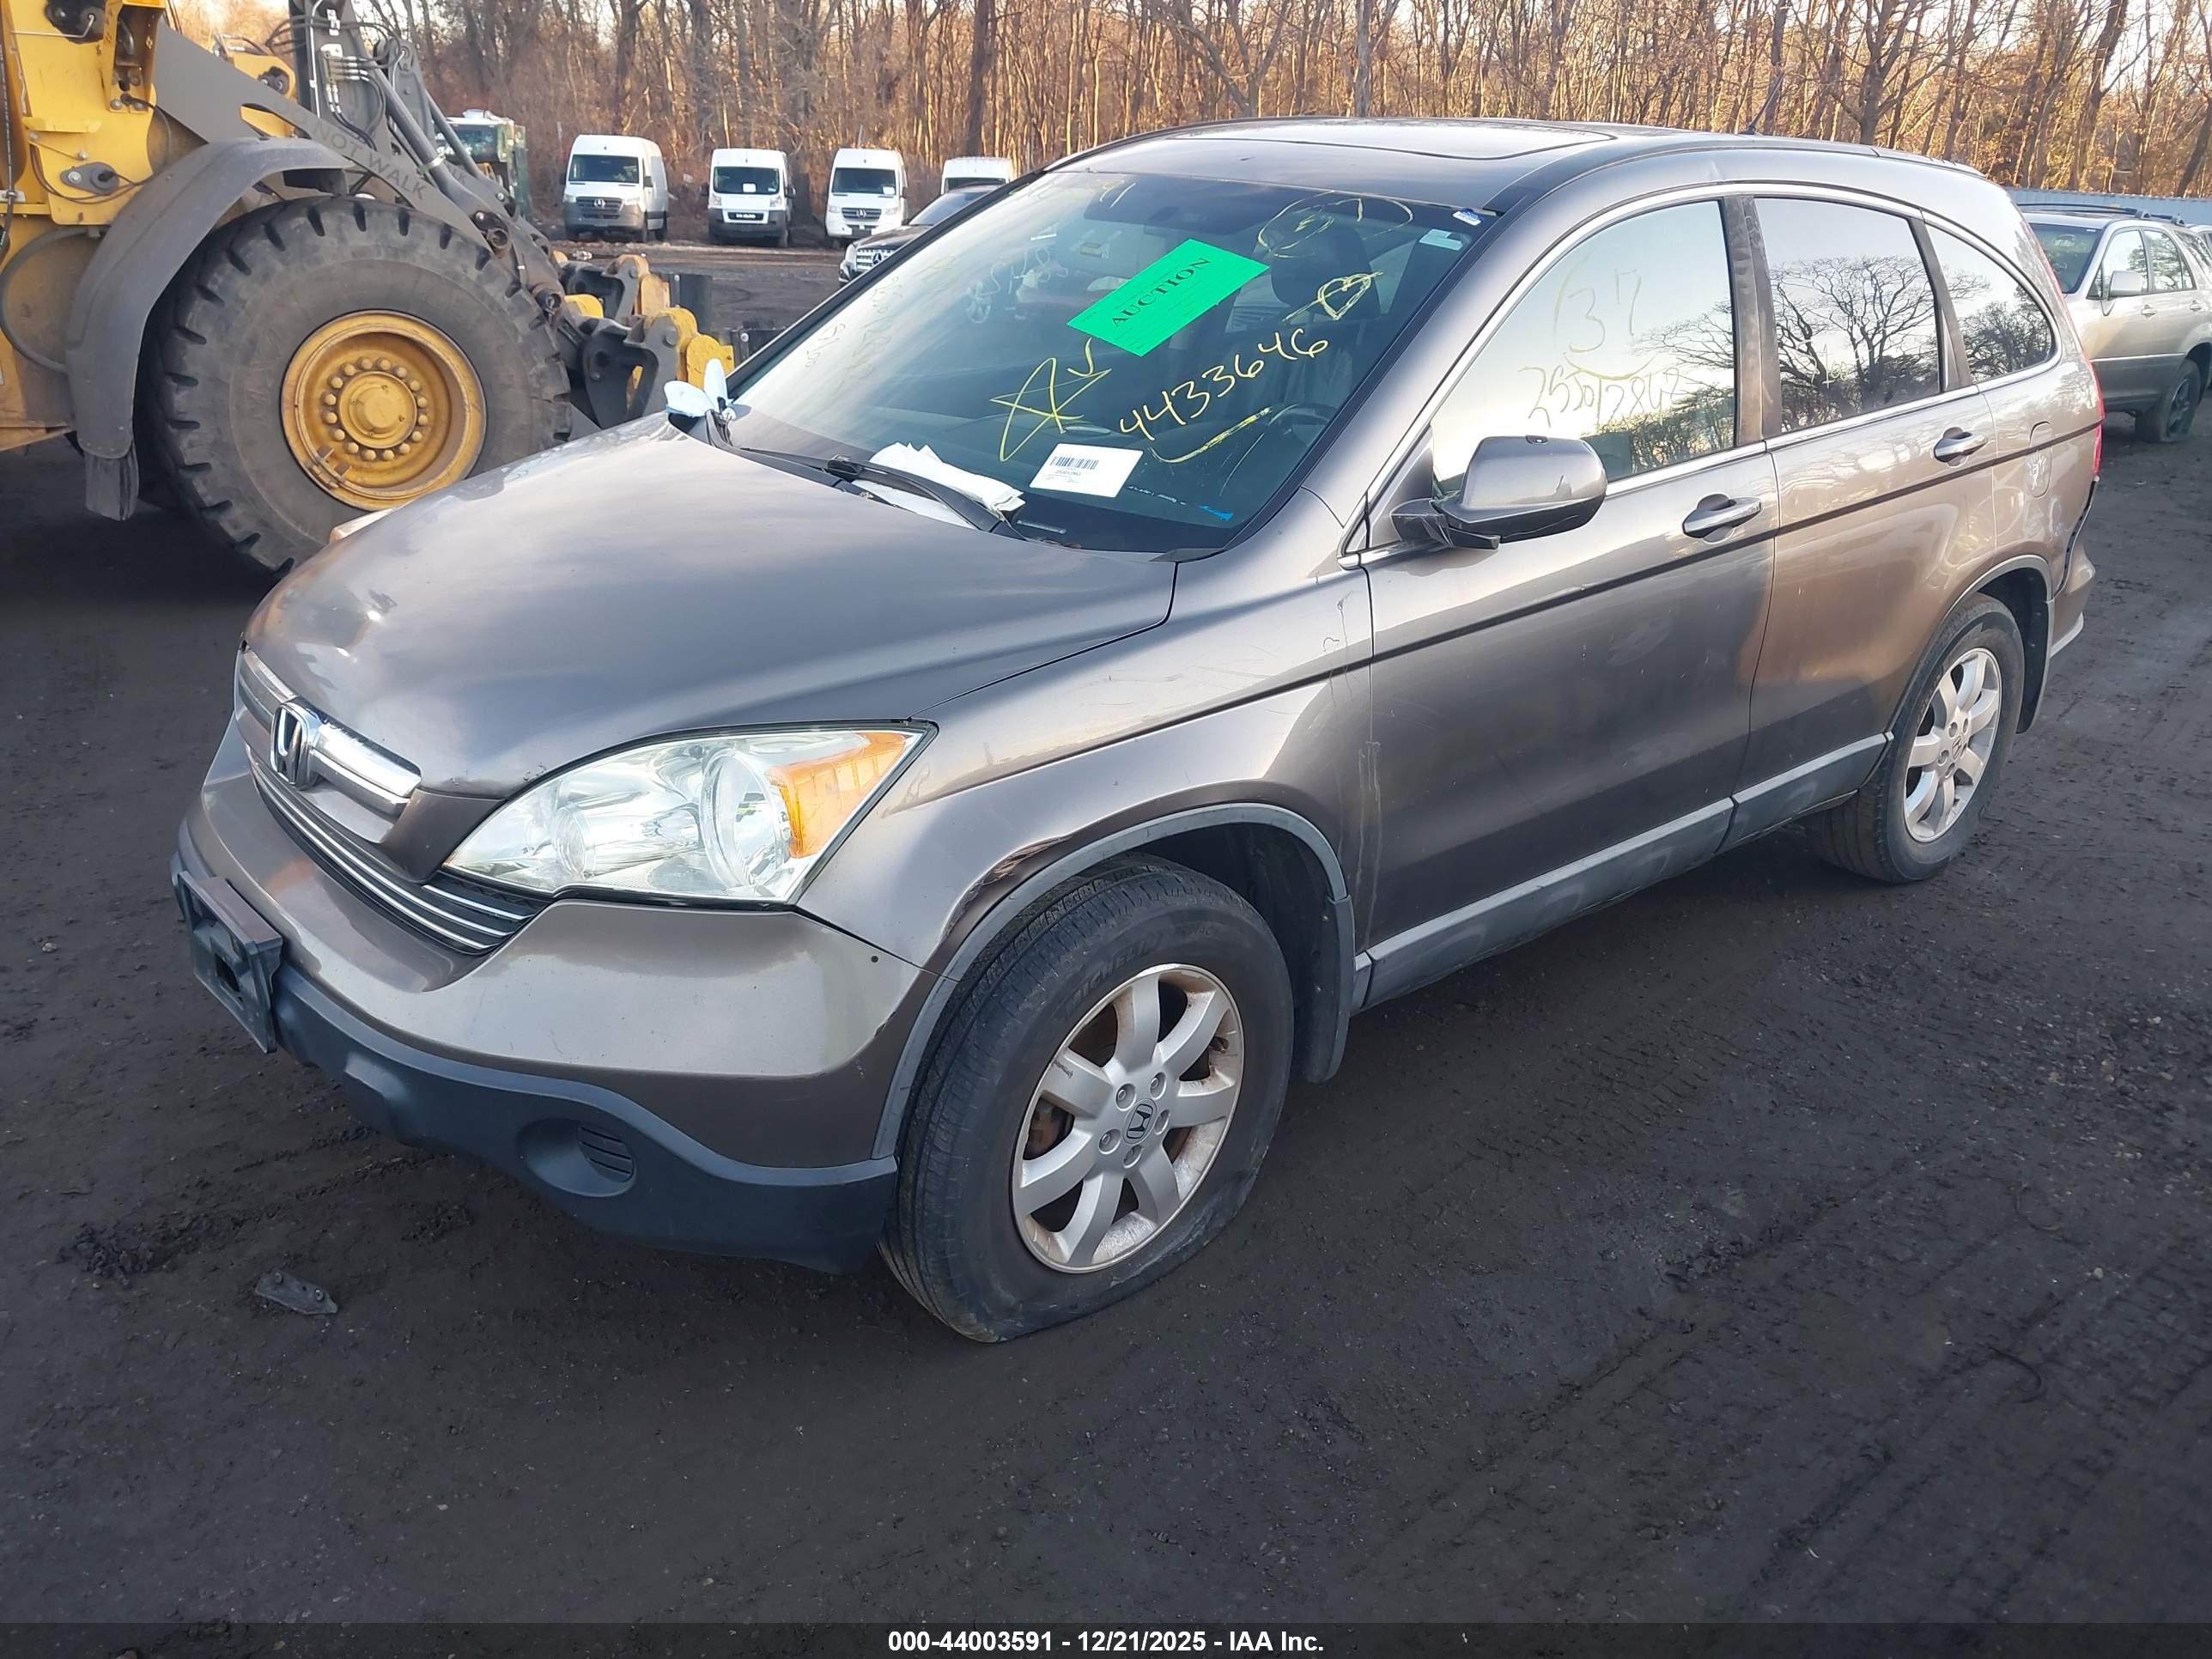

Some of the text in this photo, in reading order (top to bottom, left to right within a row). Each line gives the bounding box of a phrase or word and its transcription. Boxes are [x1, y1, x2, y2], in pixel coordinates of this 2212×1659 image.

[312, 118, 365, 158] NOT
[368, 152, 428, 201] WALK
[1111, 257, 1211, 328] AUCTION
[1119, 328, 1329, 441] 4433646
